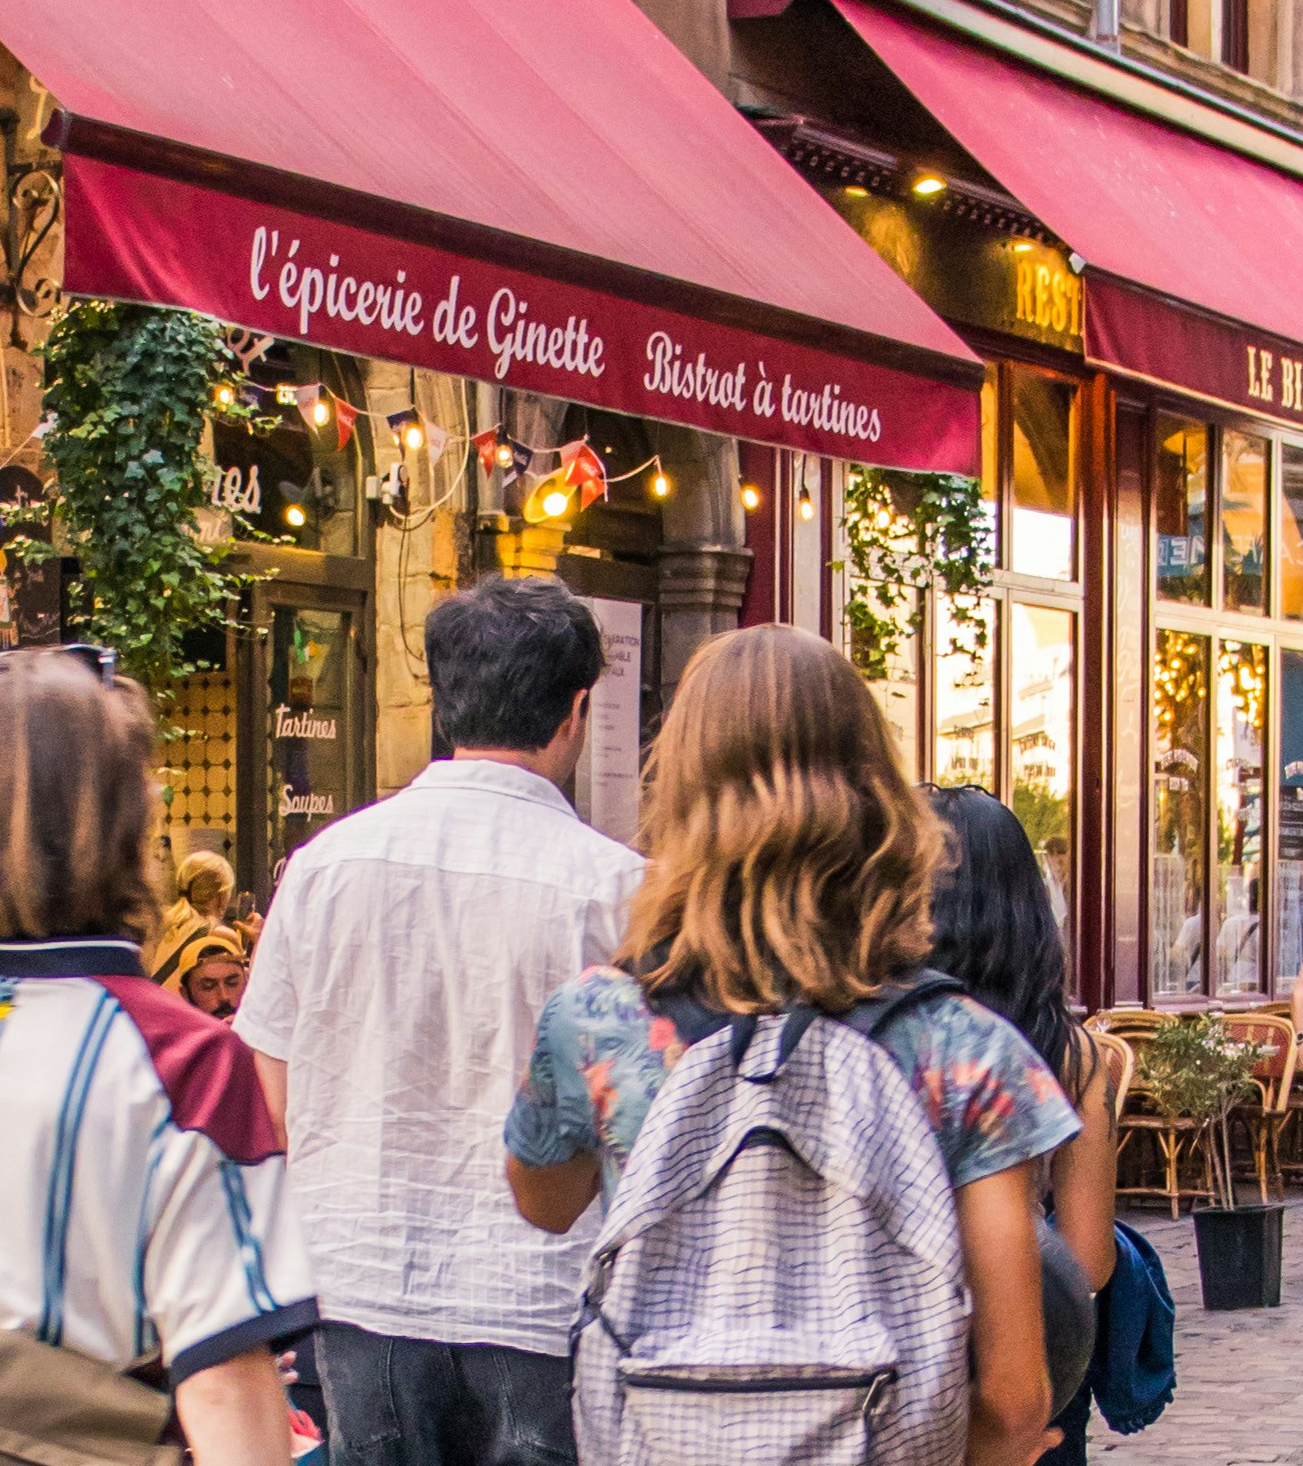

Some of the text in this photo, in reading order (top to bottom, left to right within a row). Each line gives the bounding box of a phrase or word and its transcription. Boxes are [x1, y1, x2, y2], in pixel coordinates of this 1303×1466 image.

[250, 224, 606, 379] l'épicerie de Ginette
[644, 331, 882, 443] Bistrot à tartines
[1247, 346, 1273, 402] LE
[275, 703, 336, 739] Tartines
[279, 784, 335, 822] Soupes
